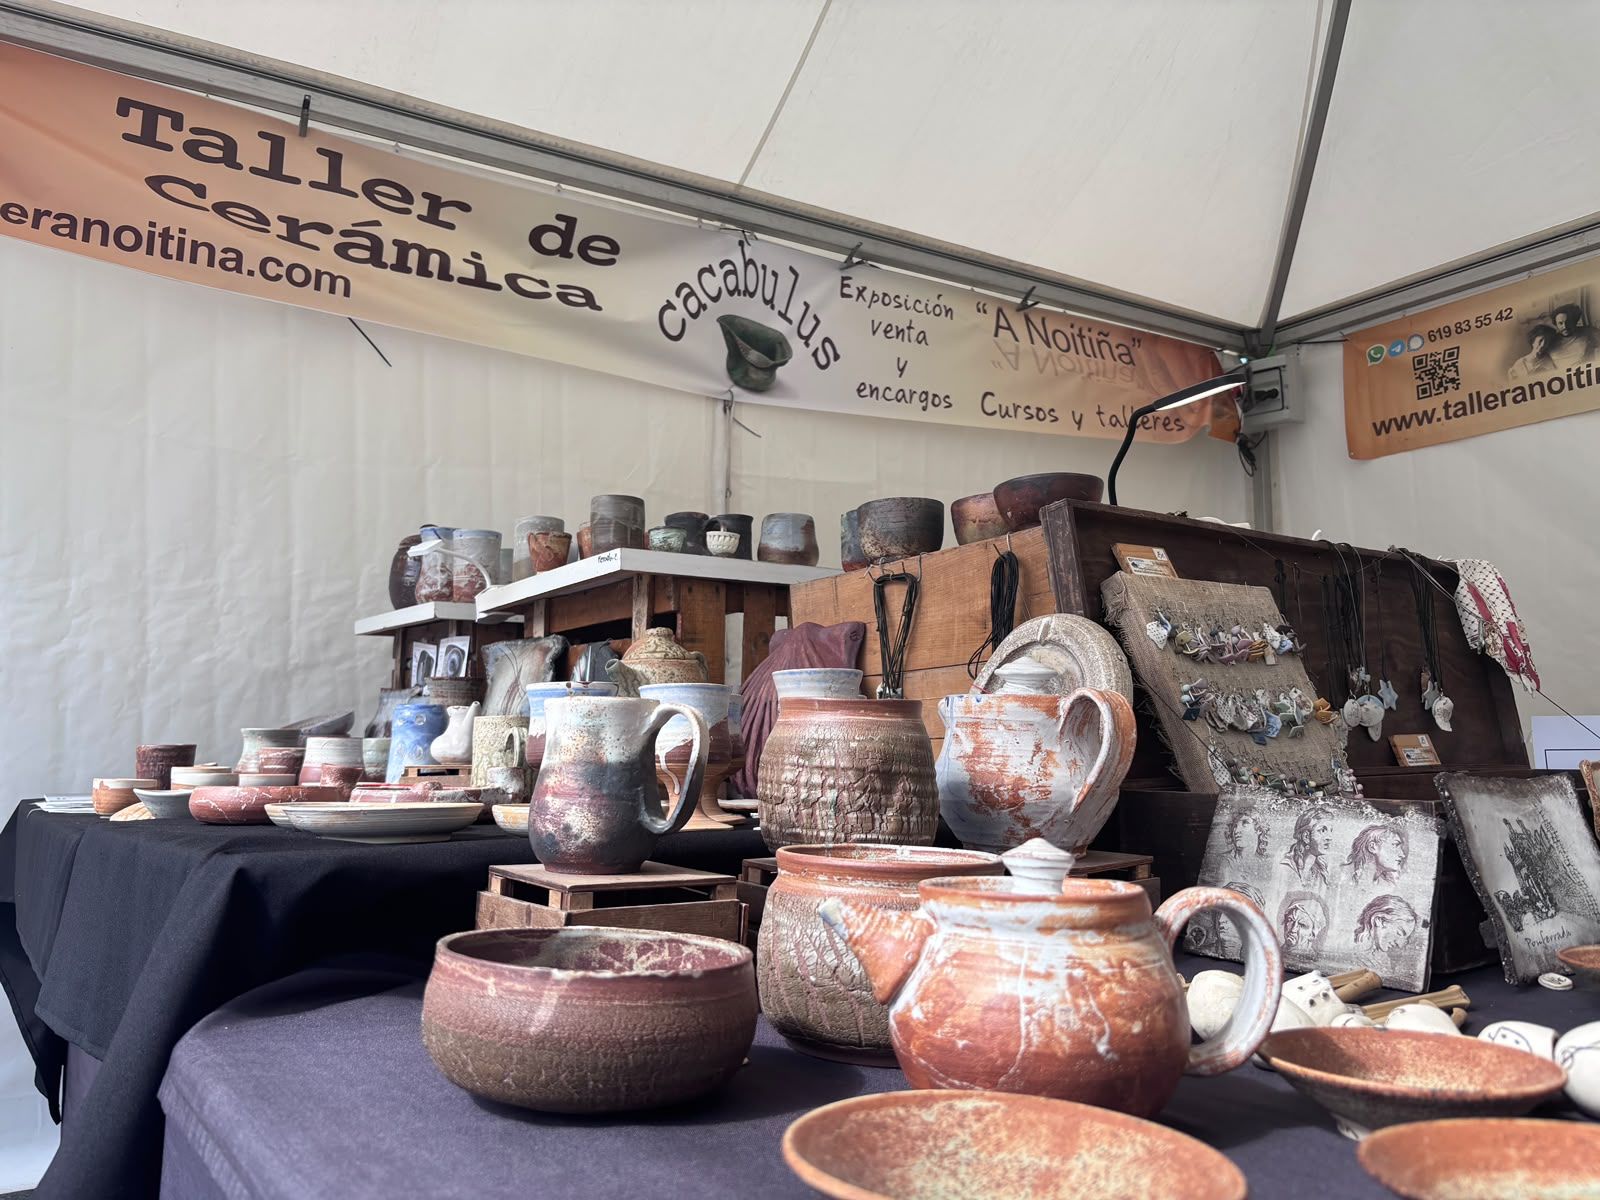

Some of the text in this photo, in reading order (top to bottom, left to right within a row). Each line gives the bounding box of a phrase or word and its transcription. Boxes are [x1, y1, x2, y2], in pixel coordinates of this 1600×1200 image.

[116, 97, 621, 266] Taller de
[0, 202, 351, 299] eranoitina.com
[658, 240, 841, 370] cacabulus
[840, 276, 954, 321] Exposición
[871, 319, 929, 346] venta
[1427, 307, 1513, 343] 619 83 55 42
[897, 357, 908, 378] y
[856, 382, 953, 411] encargos
[981, 391, 1059, 423] Cursos
[1072, 411, 1083, 431] y
[1372, 363, 1600, 437] www.talleranoiti
